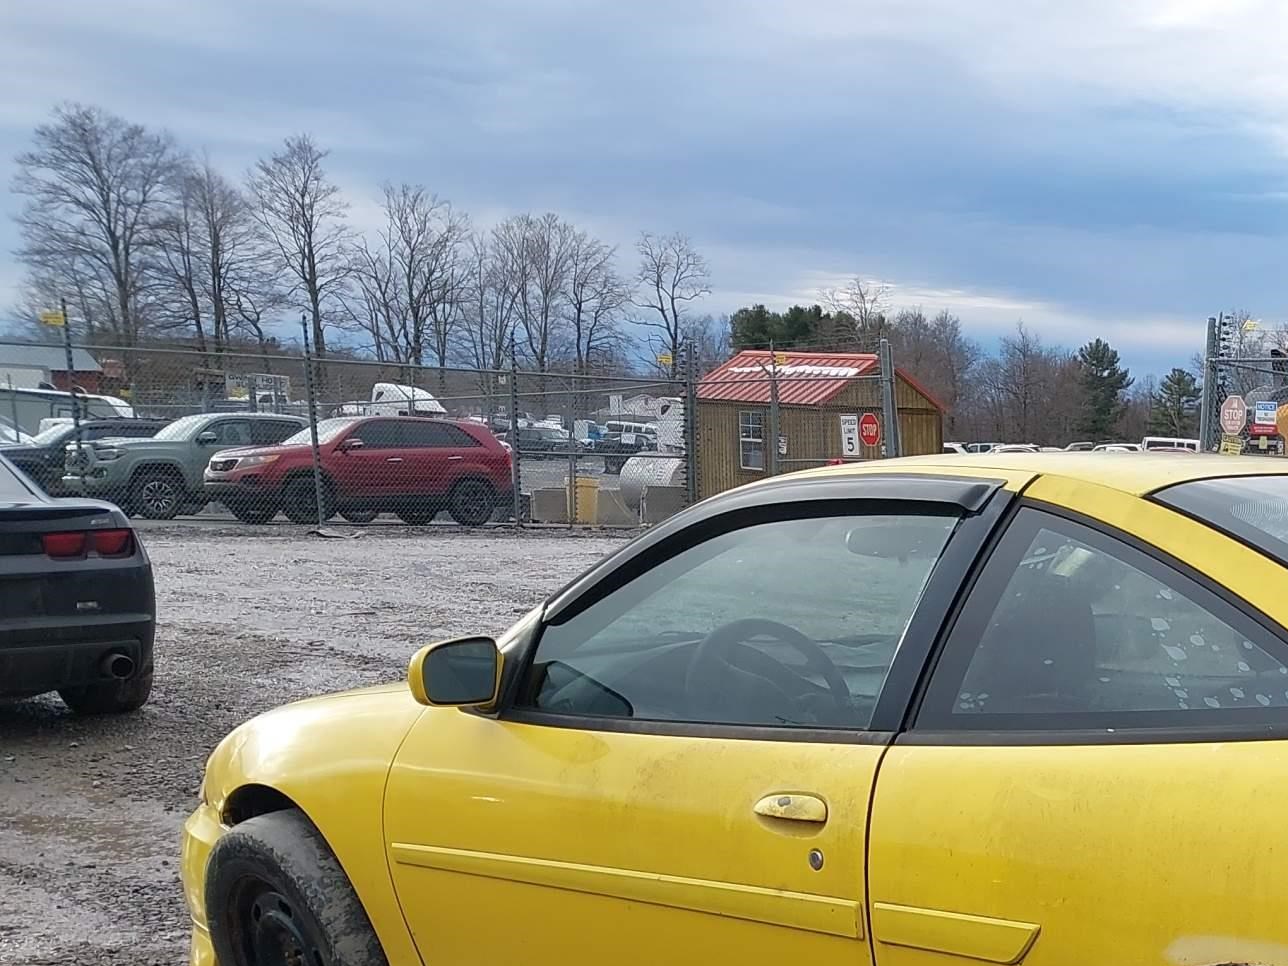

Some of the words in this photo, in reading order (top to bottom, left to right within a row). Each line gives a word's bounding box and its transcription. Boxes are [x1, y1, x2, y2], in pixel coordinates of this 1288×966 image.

[1224, 410, 1243, 420] STOP
[843, 427, 856, 435] LIMIT
[862, 423, 878, 436] STOP
[847, 437, 855, 452] 5
